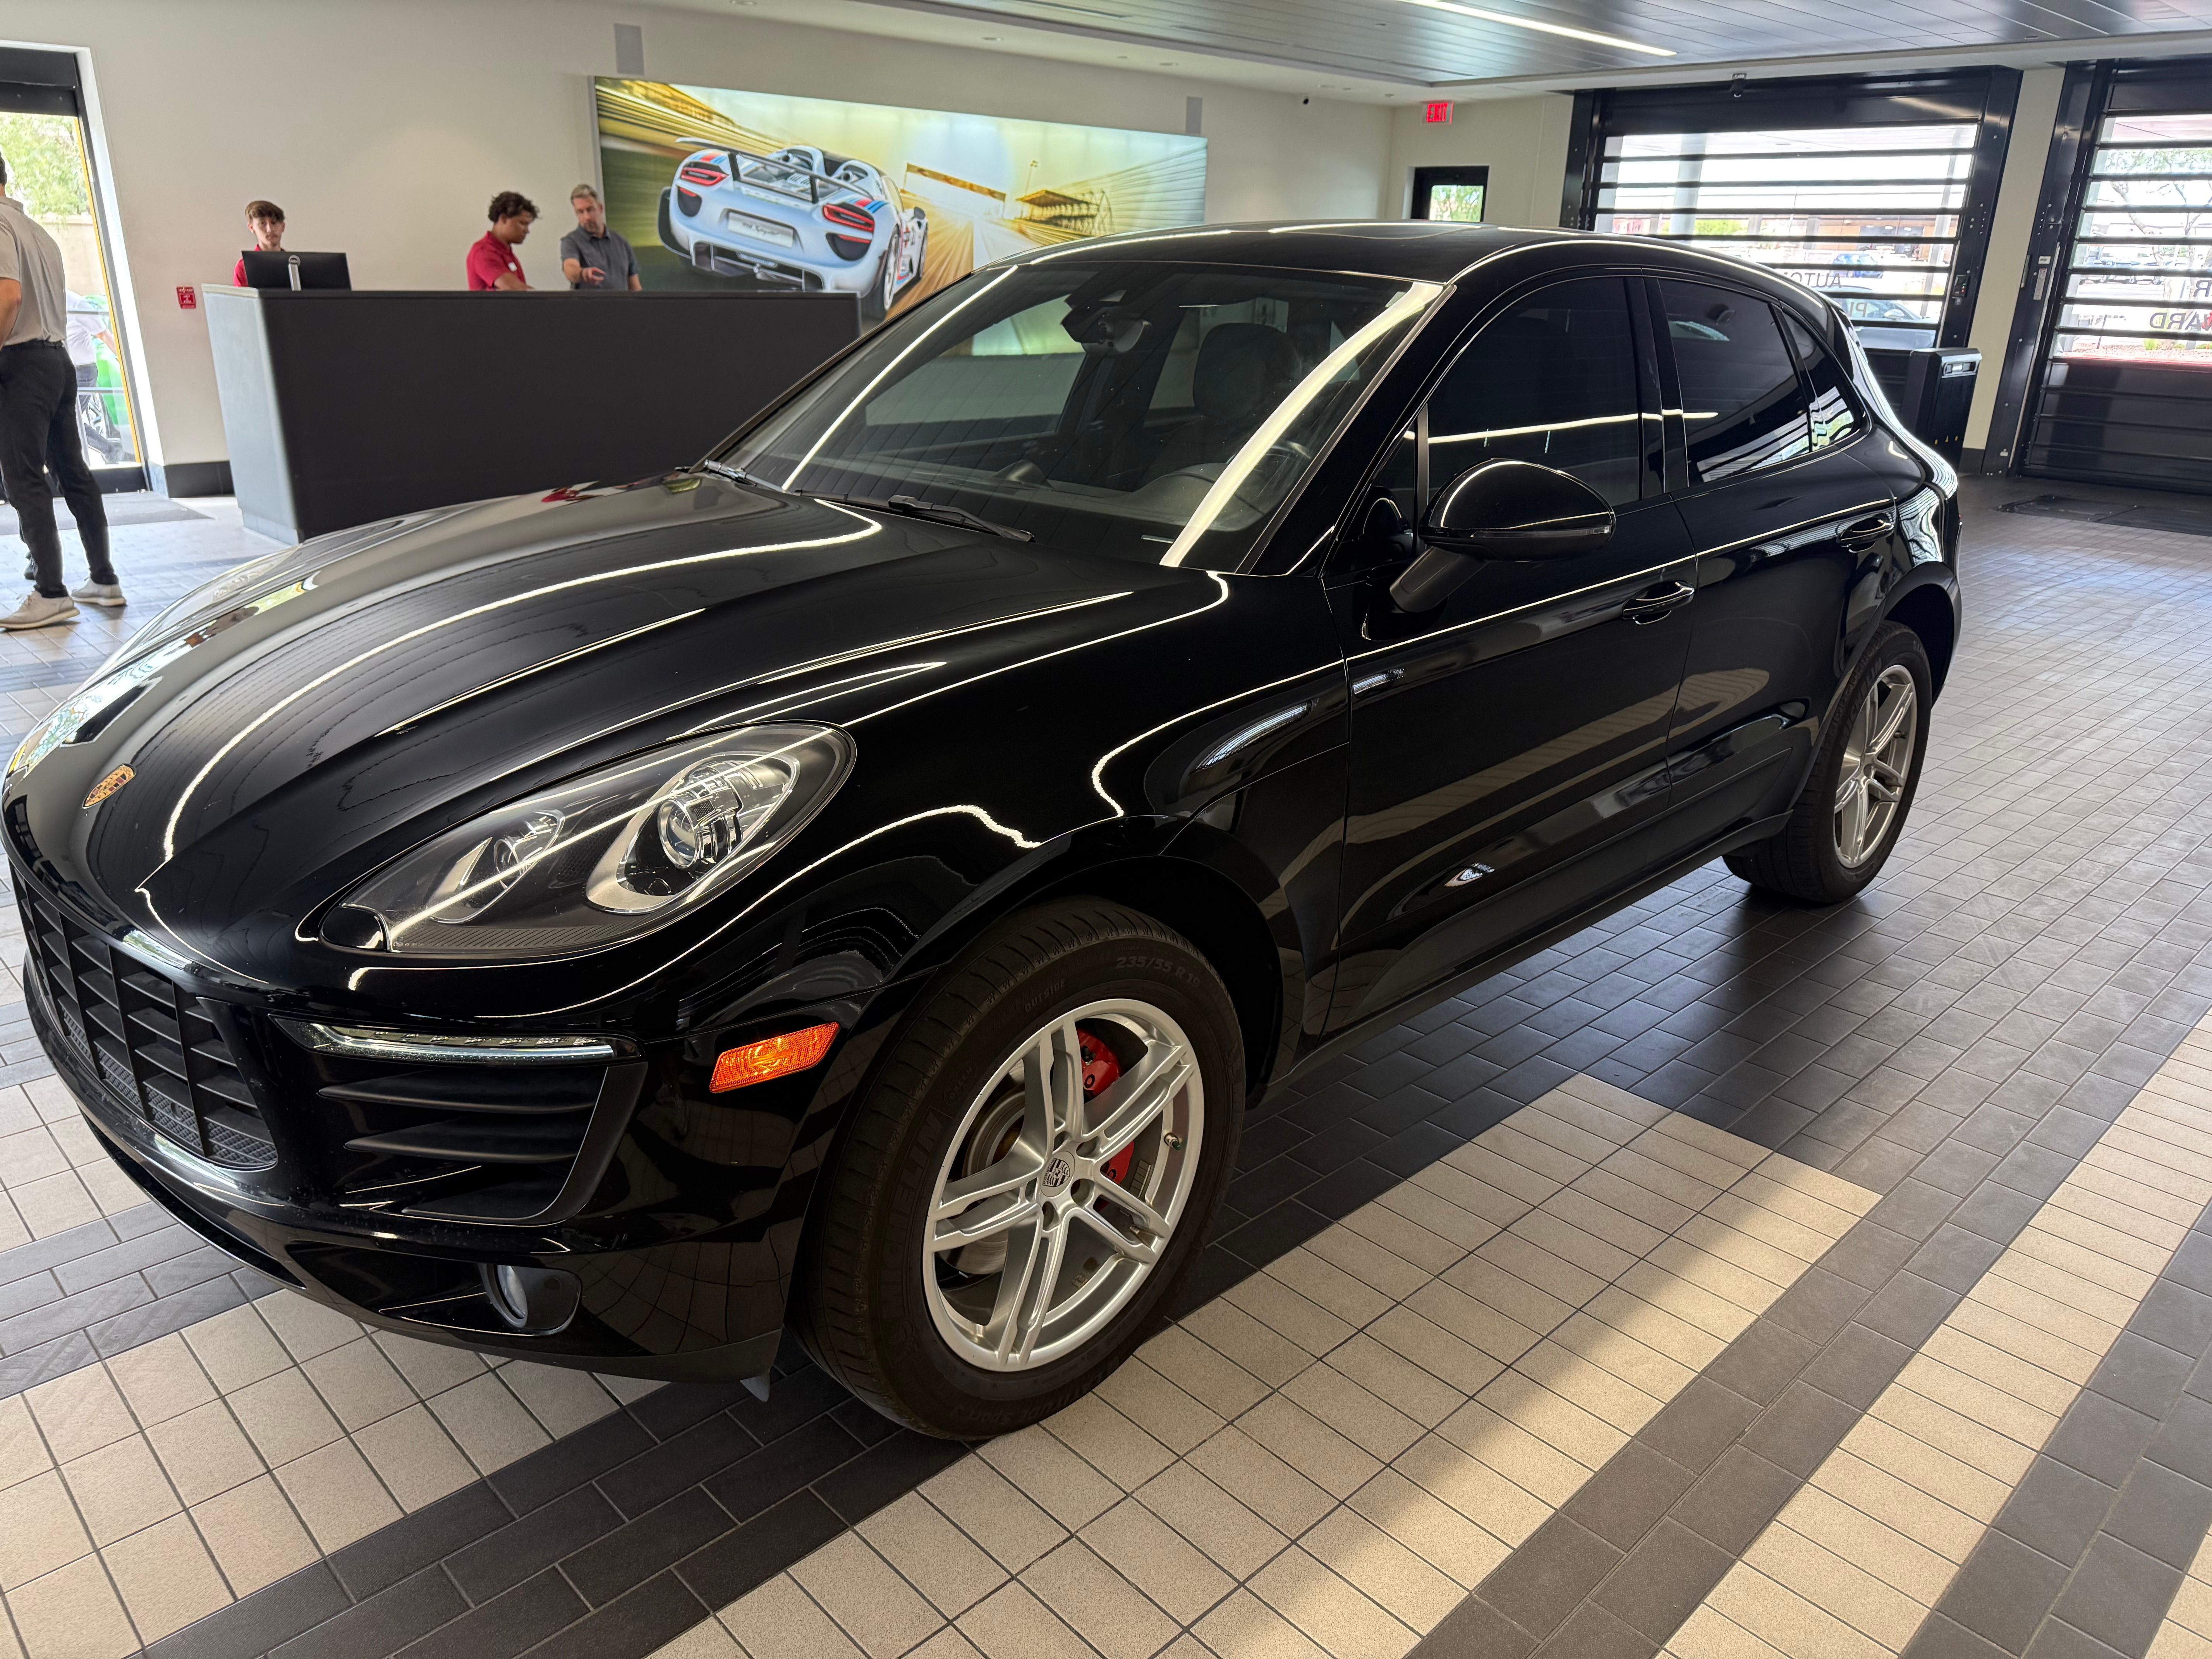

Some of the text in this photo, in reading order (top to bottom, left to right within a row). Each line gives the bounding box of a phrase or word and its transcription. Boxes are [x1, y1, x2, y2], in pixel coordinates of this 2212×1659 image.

[1427, 103, 1448, 122] EXIT
[1115, 956, 1200, 987] 235/55 R 19
[1025, 979, 1065, 1012] OUTSIDE
[880, 1110, 942, 1319] MICHELIN
